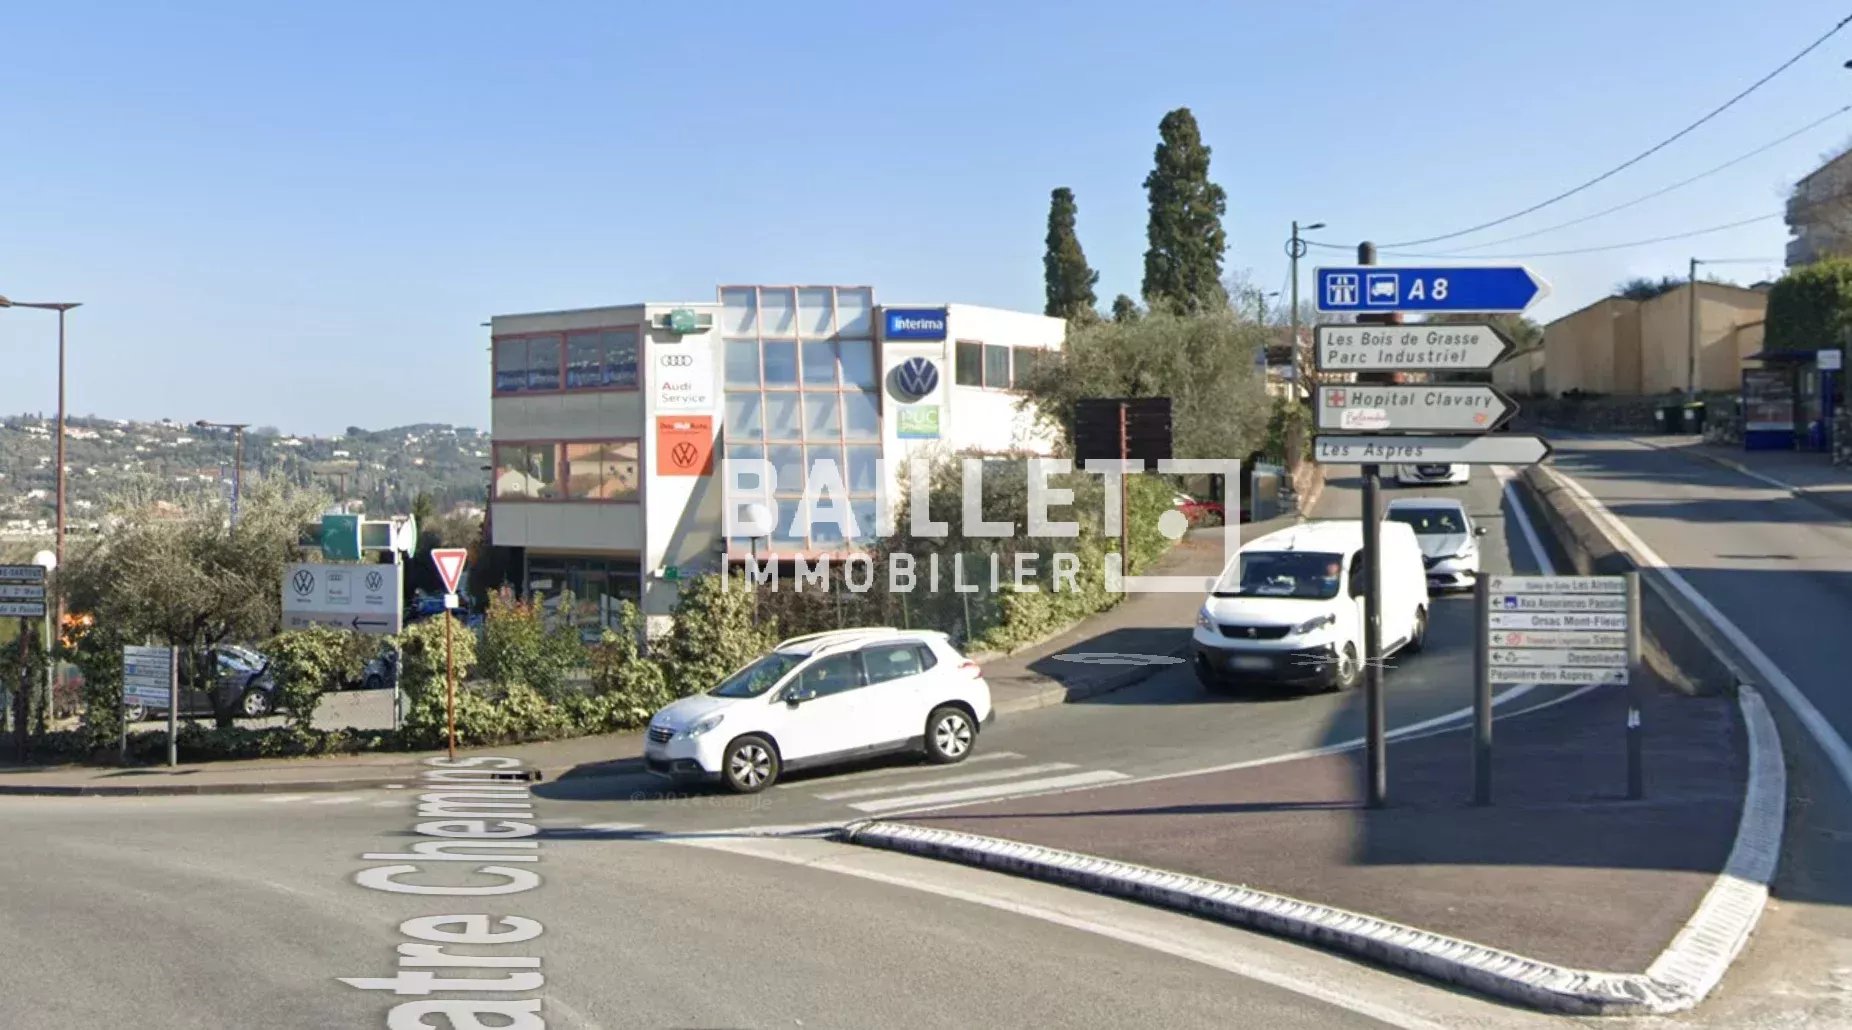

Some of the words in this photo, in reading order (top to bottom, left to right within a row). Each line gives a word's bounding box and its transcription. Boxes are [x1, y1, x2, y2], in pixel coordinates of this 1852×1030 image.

[894, 316, 943, 331] interima
[1327, 332, 1353, 346] Les
[1361, 332, 1393, 346] Bois
[1401, 332, 1418, 346] de
[1426, 332, 1479, 346] Grasse
[1327, 350, 1367, 364] Parc
[1378, 349, 1467, 364] Industriel
[661, 381, 692, 392] Audi
[661, 393, 705, 403] Service
[1351, 391, 1415, 409] Hopital
[1424, 391, 1493, 409] Clavary
[1322, 443, 1349, 456] Les
[1363, 443, 1423, 459] Aspres
